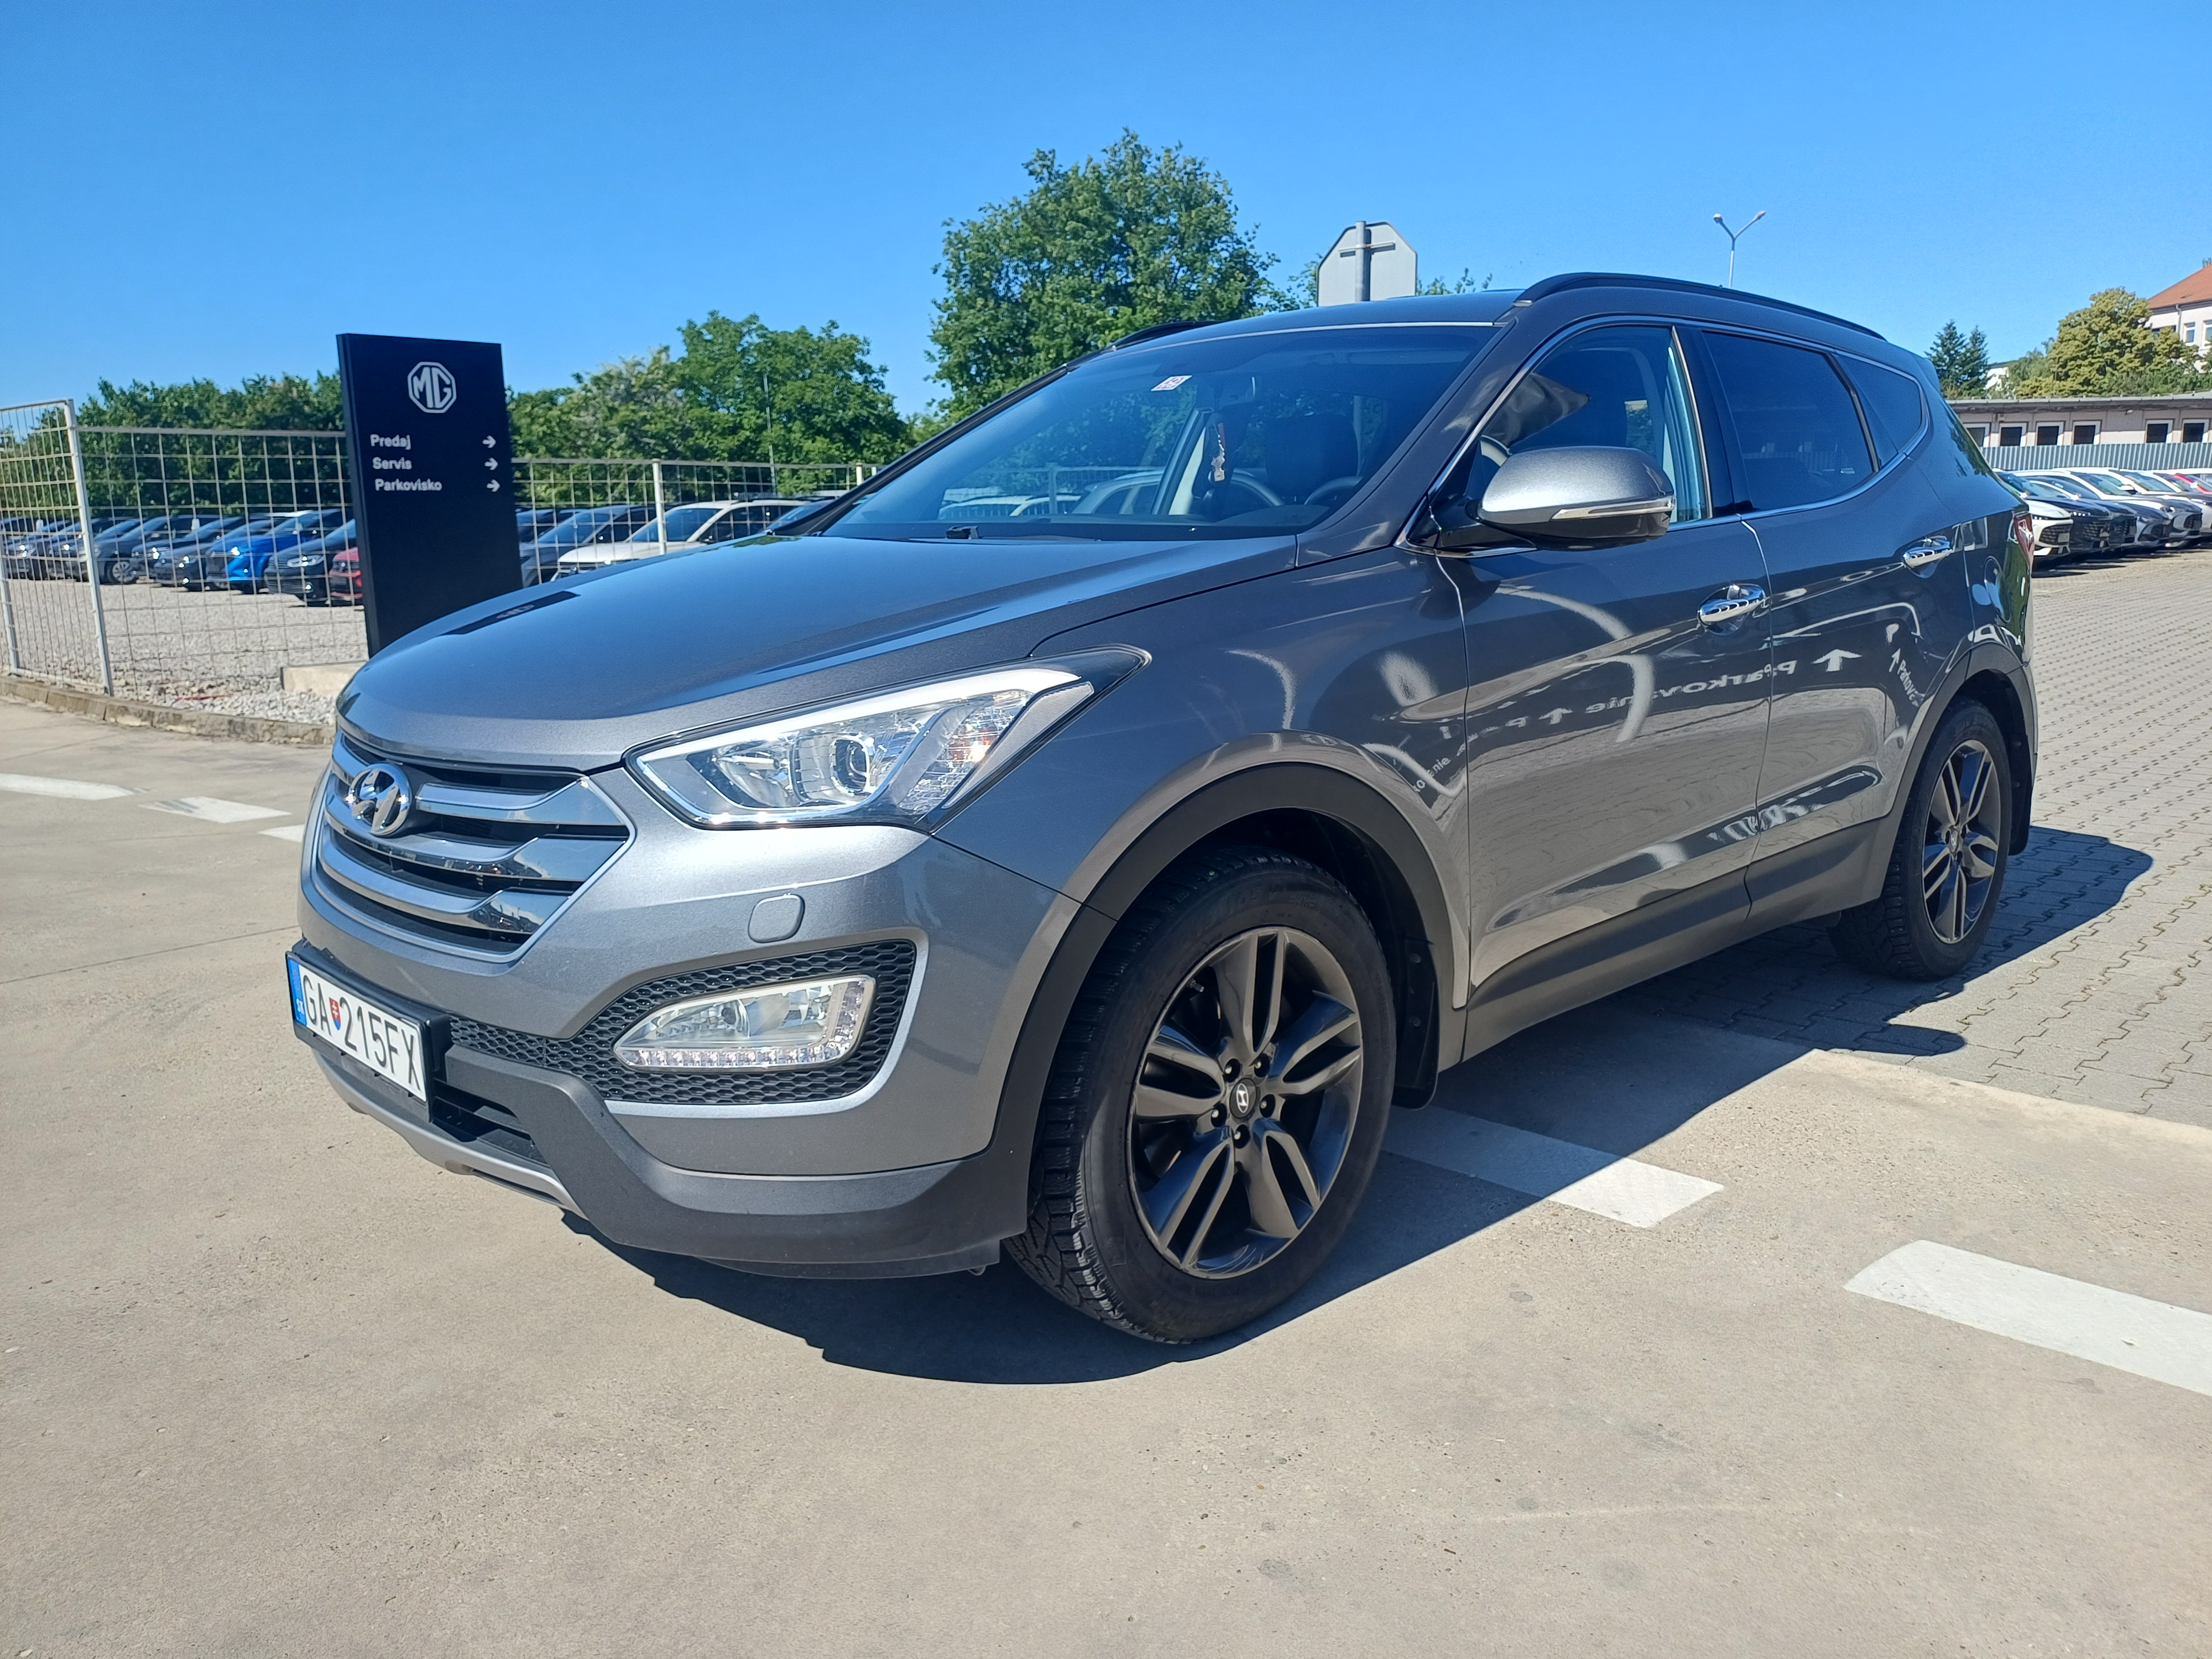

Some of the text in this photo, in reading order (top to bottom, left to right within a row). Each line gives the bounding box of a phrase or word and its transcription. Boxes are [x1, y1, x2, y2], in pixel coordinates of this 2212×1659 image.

[413, 367, 451, 409] MG
[370, 434, 411, 450] Predaj
[372, 457, 412, 470] Servis
[375, 478, 442, 492] Parkovisko
[302, 975, 423, 1092] GA 215FX
